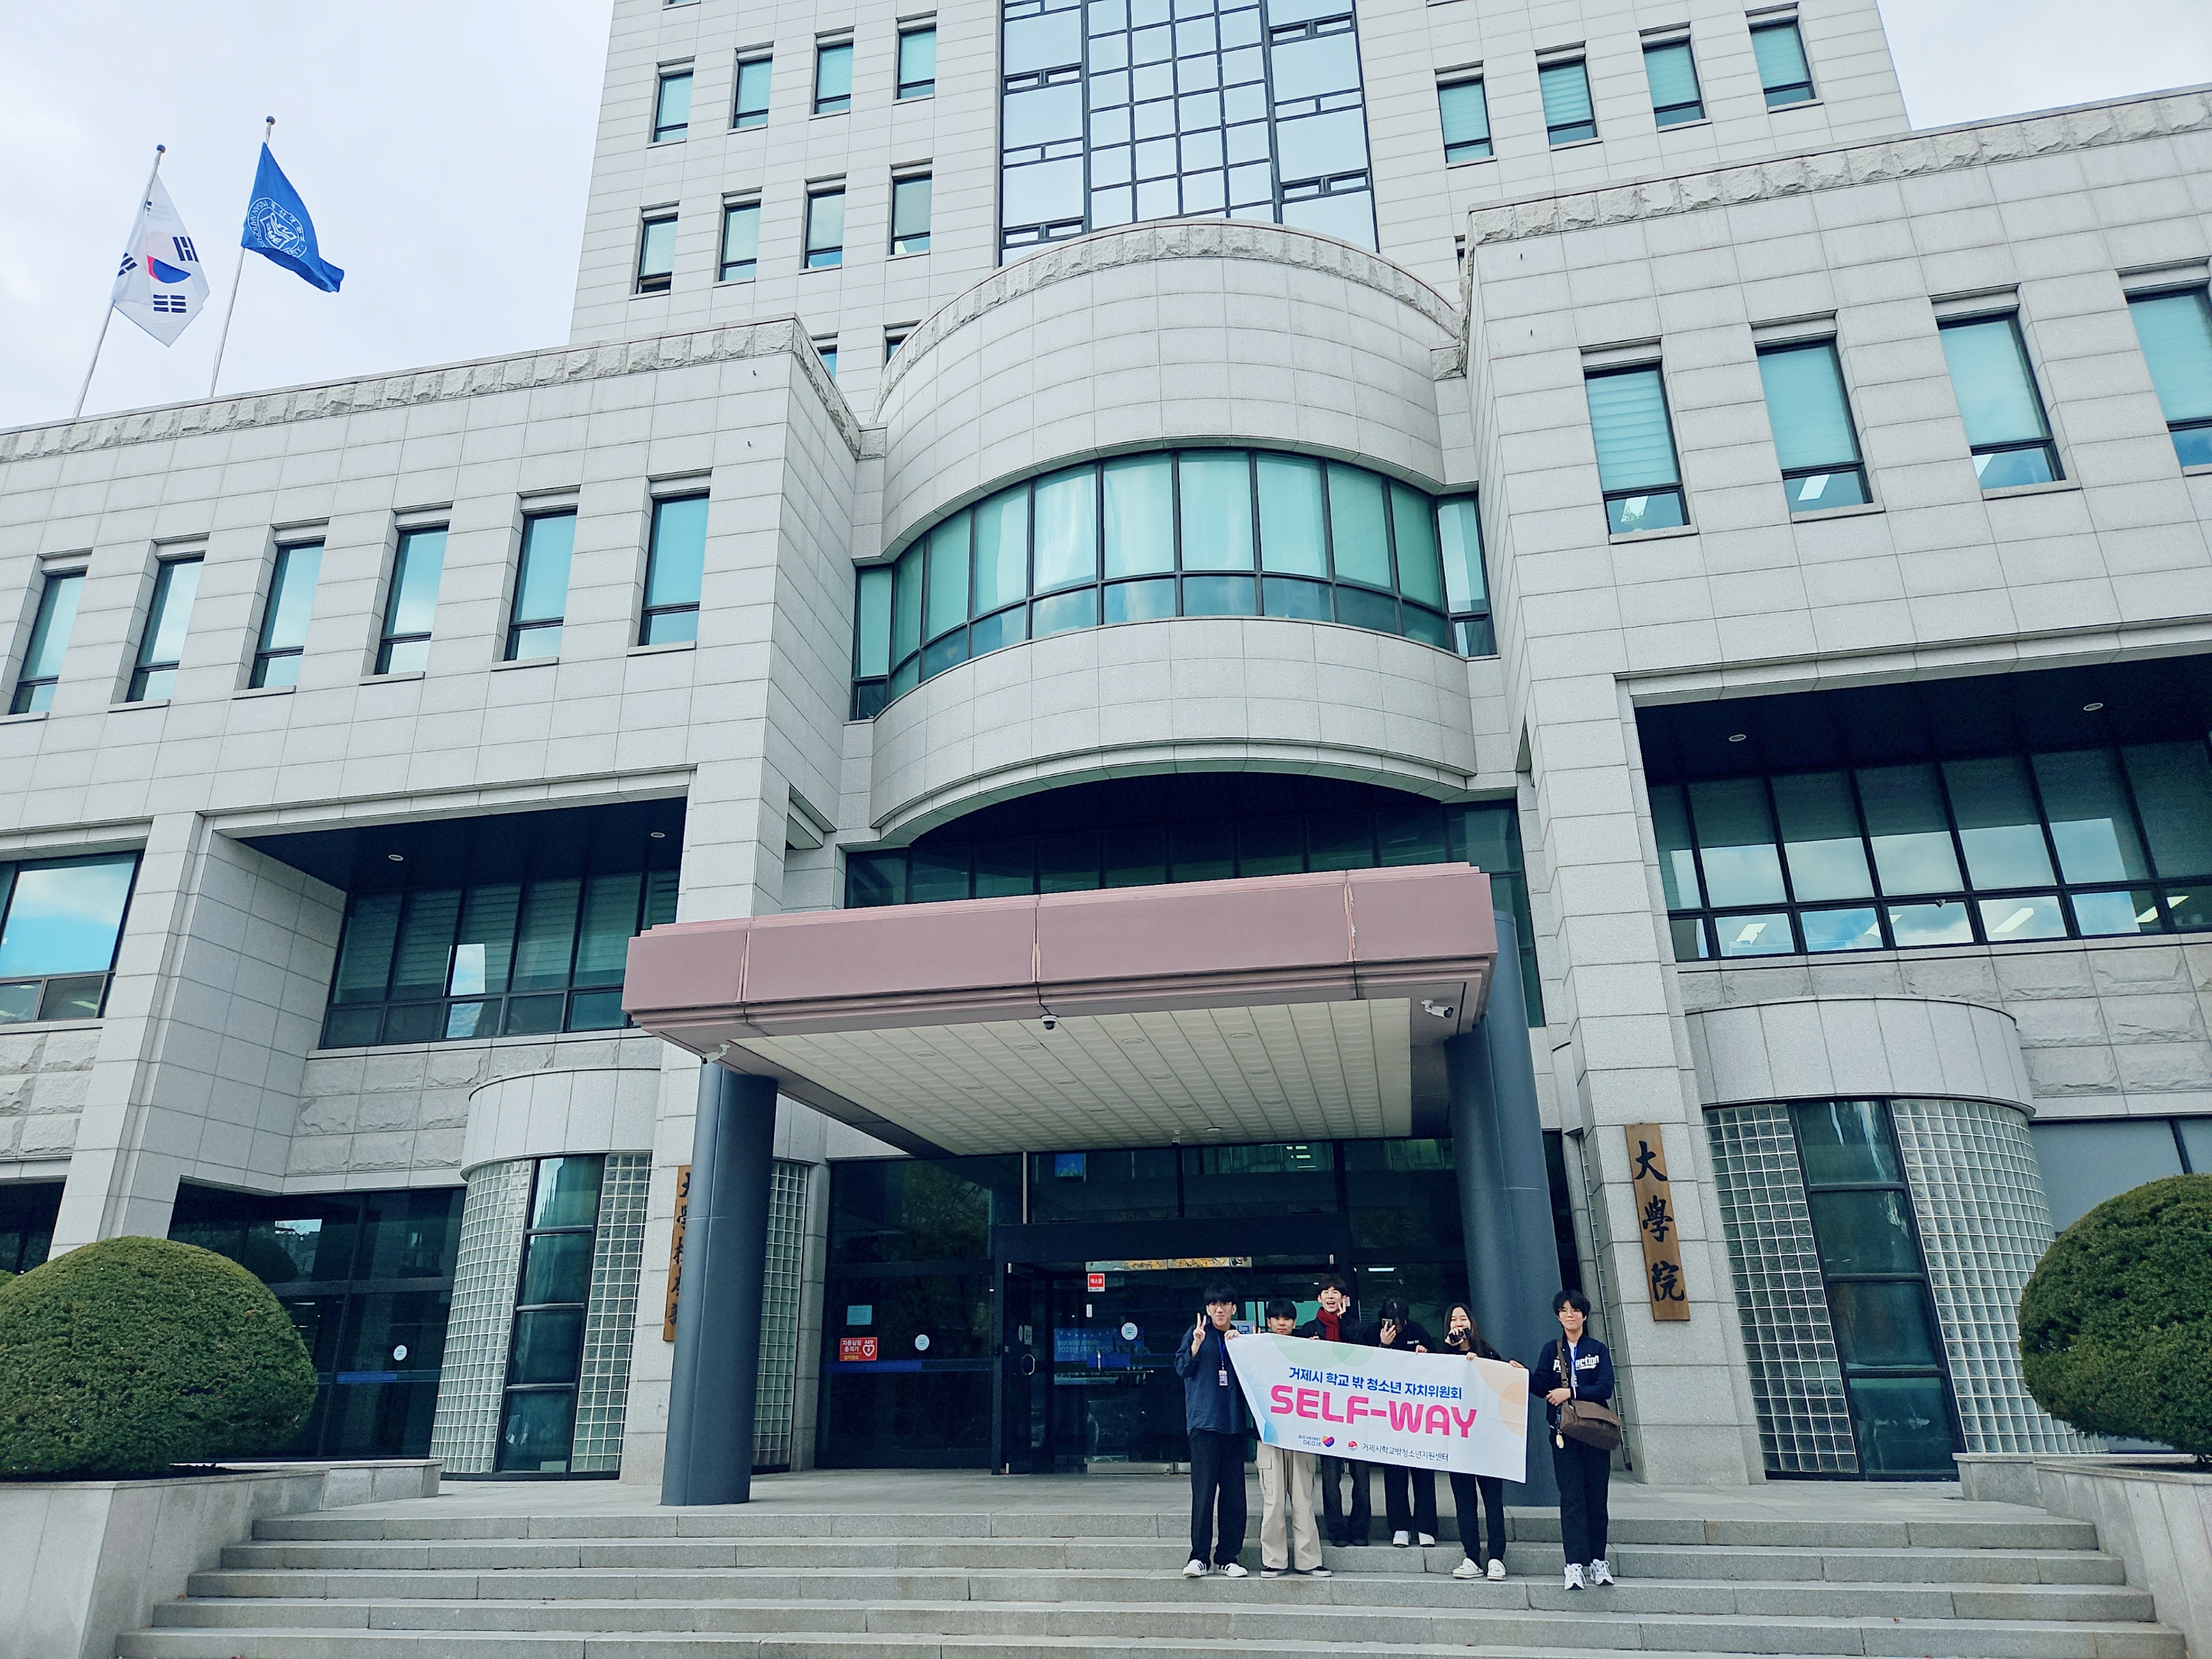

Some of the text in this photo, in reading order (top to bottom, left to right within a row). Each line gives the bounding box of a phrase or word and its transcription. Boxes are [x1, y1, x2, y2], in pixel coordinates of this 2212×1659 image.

[1634, 1141, 1685, 1302] 大學院
[1288, 1366, 1462, 1399] 거제시 학교 밖 청소년 자치위원회
[1270, 1384, 1478, 1439] SELF-WAY
[1362, 1442, 1449, 1462] 거제시학교밖청소년지원센터
